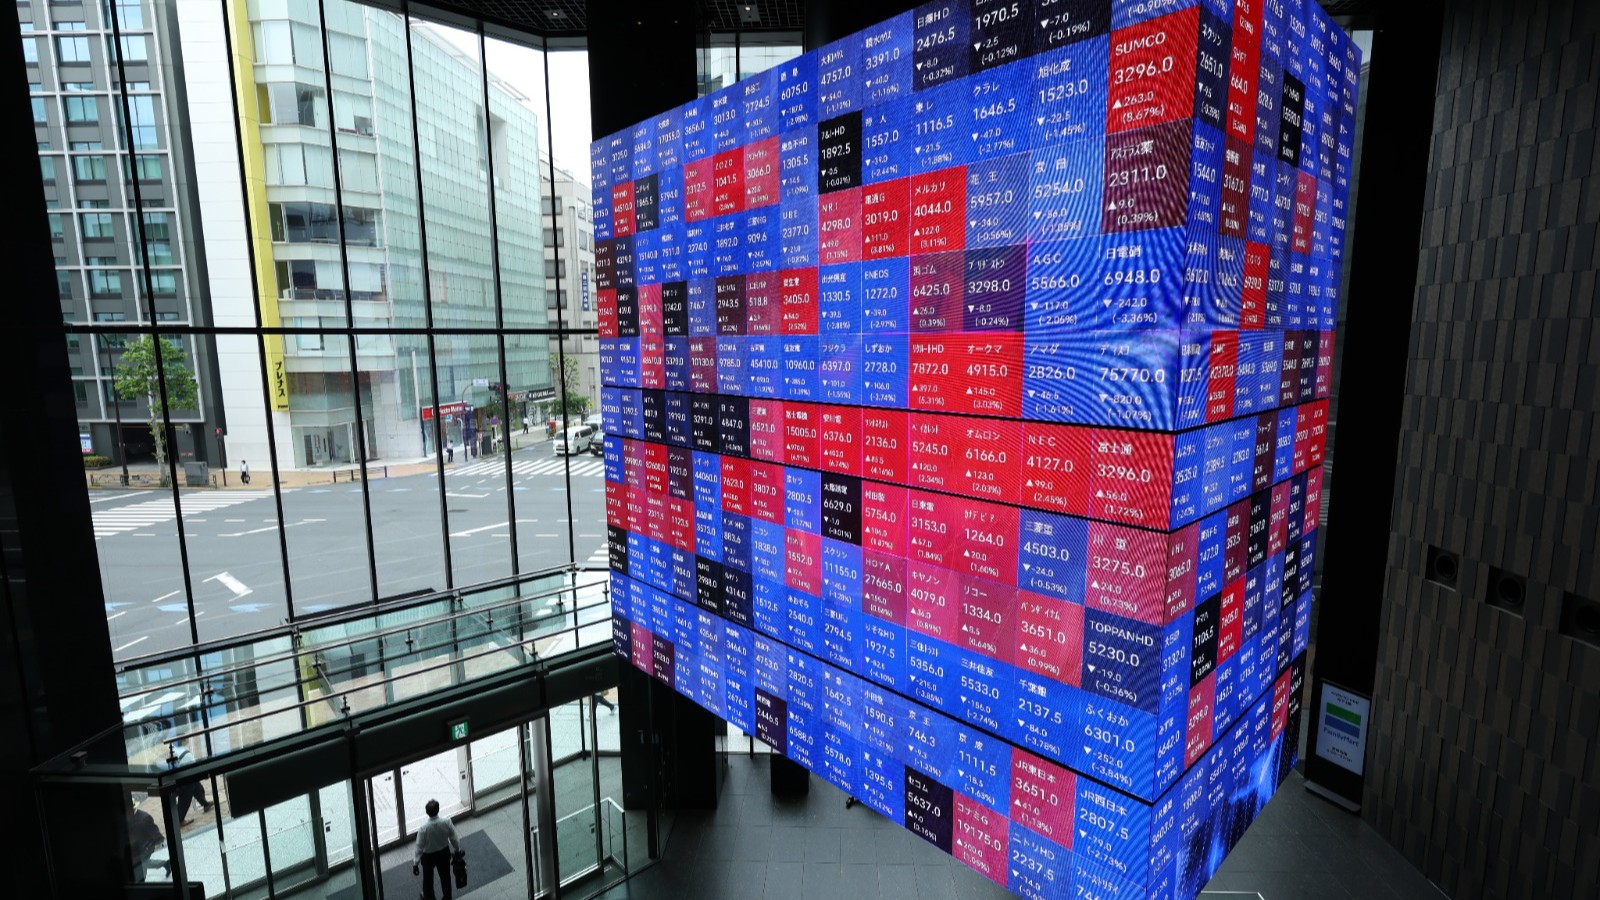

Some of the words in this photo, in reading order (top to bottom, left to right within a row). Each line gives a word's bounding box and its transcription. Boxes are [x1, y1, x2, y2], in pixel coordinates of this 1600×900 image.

[975, 1, 1019, 31] 1970.5
[916, 25, 954, 52] 2476.5
[1116, 30, 1166, 58] SUMCO
[866, 46, 899, 70] 3391.0
[821, 64, 850, 86] 4757.0
[1039, 59, 1070, 80] 旭化成
[1114, 54, 1174, 85] 3296.0
[781, 80, 807, 100] 6075.0
[973, 80, 998, 98] クラレ
[1038, 77, 1088, 105] 1523.0
[1124, 89, 1153, 106] 263.0
[746, 95, 769, 113] 2724.5
[972, 97, 1015, 121] 1646.5
[1123, 102, 1164, 123] (8.67%)
[916, 114, 953, 136] 1116.5
[866, 128, 899, 148] 1557.0
[821, 142, 850, 160] 1892.5
[782, 153, 808, 170] 1305.5
[747, 163, 770, 179] 3066.0
[1110, 162, 1168, 187] 2311.0
[914, 180, 944, 196] メルカリ
[1035, 176, 1084, 199] 5254.0
[970, 188, 1013, 208] 5957.0
[1119, 196, 1134, 208] 9.0
[865, 208, 897, 225] 3019.0
[914, 199, 951, 217] 4044.0
[1118, 208, 1158, 225] (0.39%)
[782, 224, 808, 238] 2377.0
[821, 216, 850, 232] 4298.0
[748, 231, 766, 243] 909.6
[1105, 245, 1140, 260] 日電硝
[865, 268, 888, 279] ENEOS
[1031, 273, 1080, 290] 5566.0
[1104, 268, 1160, 286] 6948.0
[865, 286, 897, 299] 1272.0
[913, 283, 949, 297] 6425.0
[968, 278, 1009, 294] 3298.0
[749, 296, 767, 306] 518.8
[784, 292, 809, 304] 3405.0
[822, 289, 850, 302] 1330.5
[864, 343, 890, 352] しずおか
[967, 343, 1001, 354] オークマ
[1029, 343, 1059, 354] アマダ
[751, 359, 777, 369] 45410.0
[785, 359, 814, 370] 10960.0
[822, 360, 850, 371] 6397.0
[864, 361, 896, 373] 2728.0
[913, 362, 948, 375] 7872.0
[966, 363, 1007, 377] 4915.0
[1029, 365, 1076, 379] 2826.0
[275, 361, 286, 397] プレナス
[1101, 367, 1165, 383] 75770.0
[752, 421, 775, 433] 6521.0
[785, 425, 814, 438] 15005.0
[966, 427, 1000, 440] オムロン
[824, 430, 851, 443] 6376.0
[865, 435, 896, 449] 2136.0
[912, 440, 947, 456] 5245.0
[966, 447, 1006, 464] 6166.0
[1098, 440, 1132, 455] 富士通
[1027, 454, 1073, 472] 4127.0
[1097, 463, 1151, 483] 3296.0
[754, 482, 776, 496] 3807.0
[1035, 479, 1052, 490] 99.0
[787, 490, 811, 504] 2800.5
[824, 497, 851, 513] 6629.0
[1034, 492, 1066, 507] (2.45%)
[865, 506, 896, 523] 5754.0
[912, 516, 946, 534] 3153.0
[964, 527, 1004, 547] 1264.0
[755, 540, 777, 555] 1838.0
[1024, 540, 1069, 562] 4503.0
[788, 549, 812, 566] 1552.0
[1093, 554, 1146, 579] 3275.0
[825, 561, 856, 580] 11155.0
[866, 573, 901, 593] 27665.0
[963, 584, 986, 600] リコー
[756, 596, 778, 612] 1512.5
[911, 586, 945, 607] 4079.0
[788, 608, 812, 626] 2540.0
[962, 602, 1001, 625] 1334.0
[824, 622, 851, 642] 2794.5
[1021, 619, 1065, 645] 3651.0
[1089, 619, 1153, 647] TOPPANHD
[865, 638, 894, 659] 1927.5
[1088, 640, 1140, 668] 5230.0
[756, 653, 777, 671] 4753.0
[910, 655, 943, 678] 5356.0
[789, 668, 812, 688] 2820.5
[1096, 666, 1121, 682] -19.0
[825, 685, 851, 707] 1642.5
[961, 675, 999, 700] 5533.0
[1096, 679, 1136, 702] (-0.36%)
[757, 706, 778, 726] 2446.5
[864, 704, 893, 727] 1590.5
[1018, 696, 1062, 725] 2137.5
[1085, 702, 1128, 727] ふくおか
[789, 724, 813, 746] 6588.0
[909, 726, 935, 748] 746.3
[1084, 722, 1135, 754] 6301.0
[1324, 727, 1359, 747] FamilyMart
[825, 744, 850, 767] 5578.0
[958, 749, 996, 777] 1111.5
[864, 766, 892, 791] 1395.5
[1016, 758, 1055, 784] JR東日本
[908, 775, 928, 793] セコム
[1015, 776, 1058, 807] 3651.0
[908, 790, 940, 818] 5637.0
[1080, 788, 1126, 818] JR西日本
[958, 802, 988, 826] コナミG
[1079, 807, 1129, 842] 2807.5
[958, 818, 1000, 852] 19175.0
[1013, 831, 1053, 861] ニトリHD
[1012, 848, 1054, 882] 2237.5
